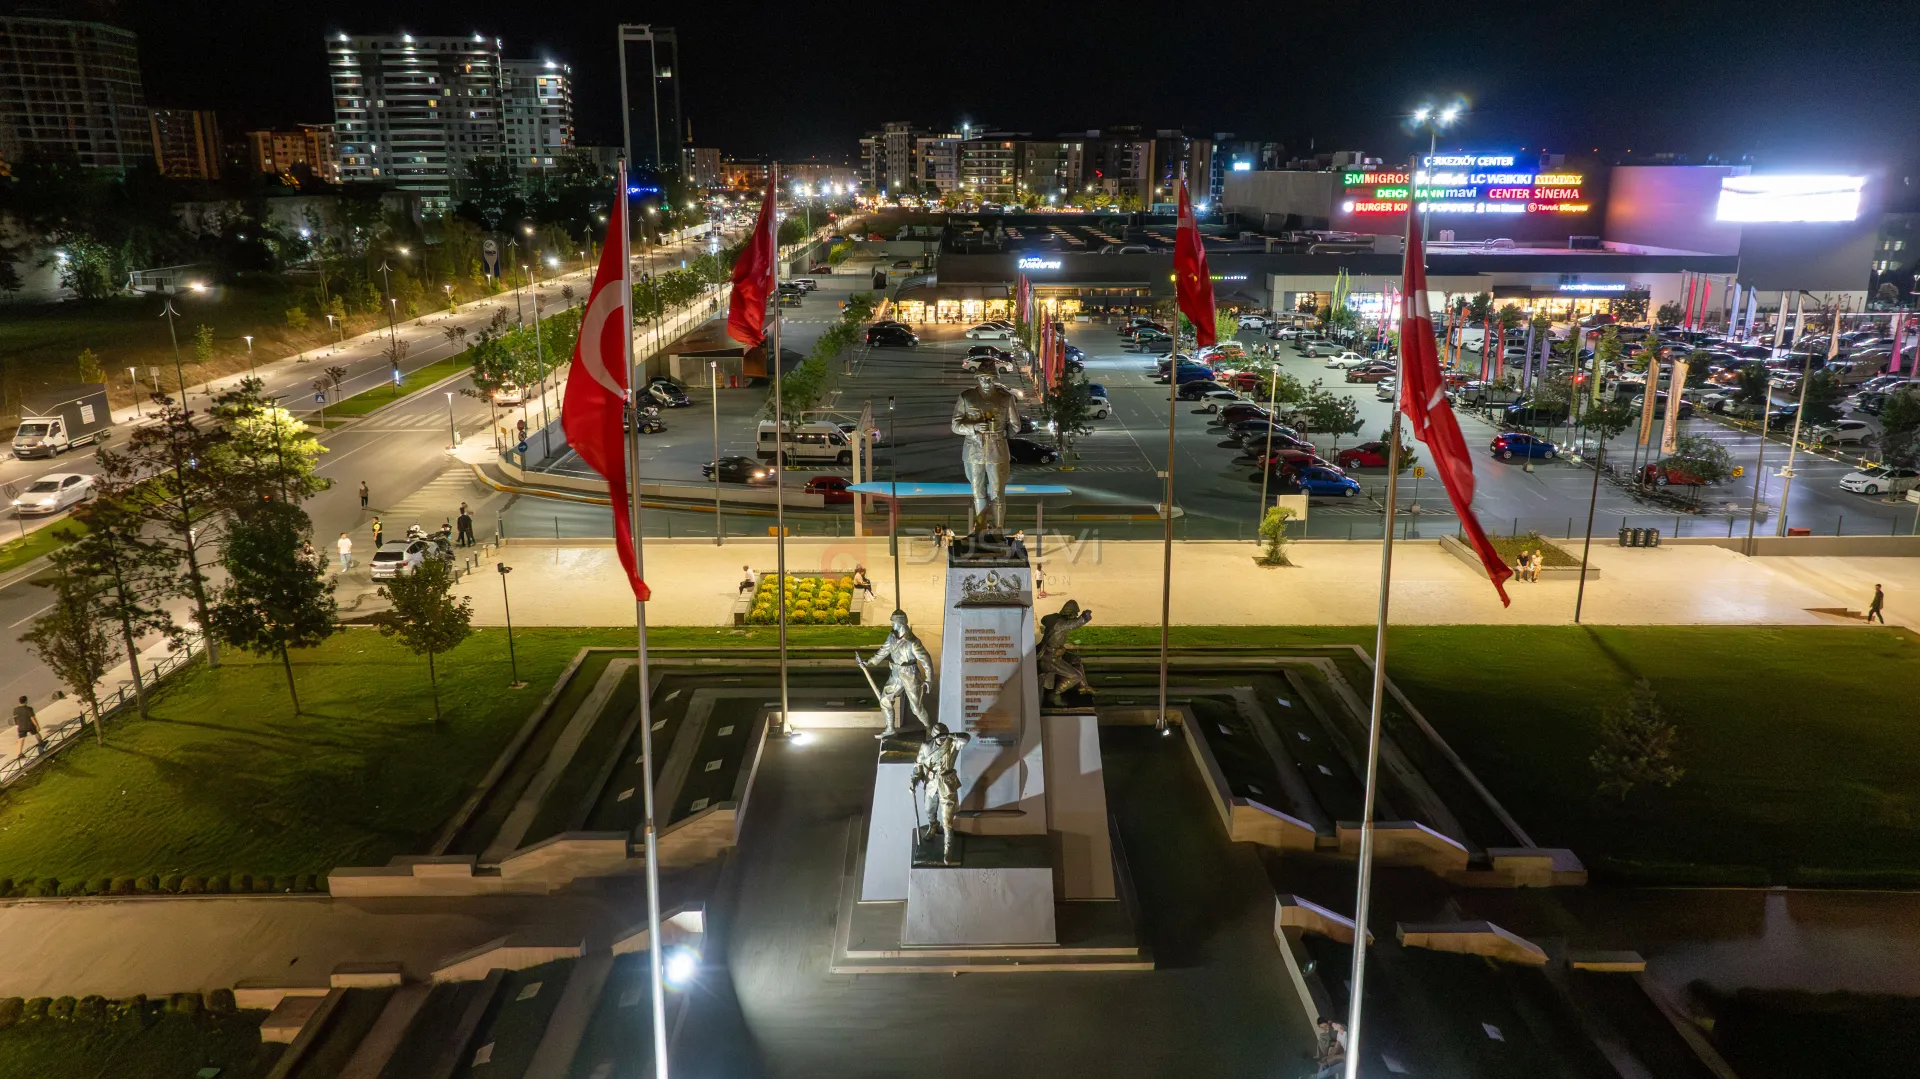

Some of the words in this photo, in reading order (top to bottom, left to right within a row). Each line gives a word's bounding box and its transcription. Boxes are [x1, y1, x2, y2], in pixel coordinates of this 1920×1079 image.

[1477, 156, 1514, 167] CENTER
[1470, 173, 1487, 184] LC
[1445, 187, 1478, 198] mavi
[1489, 188, 1530, 199] CENTER
[1534, 186, 1580, 199] SİNEMA
[1355, 202, 1393, 212] BURGER
[1018, 258, 1062, 270] Dondurma
